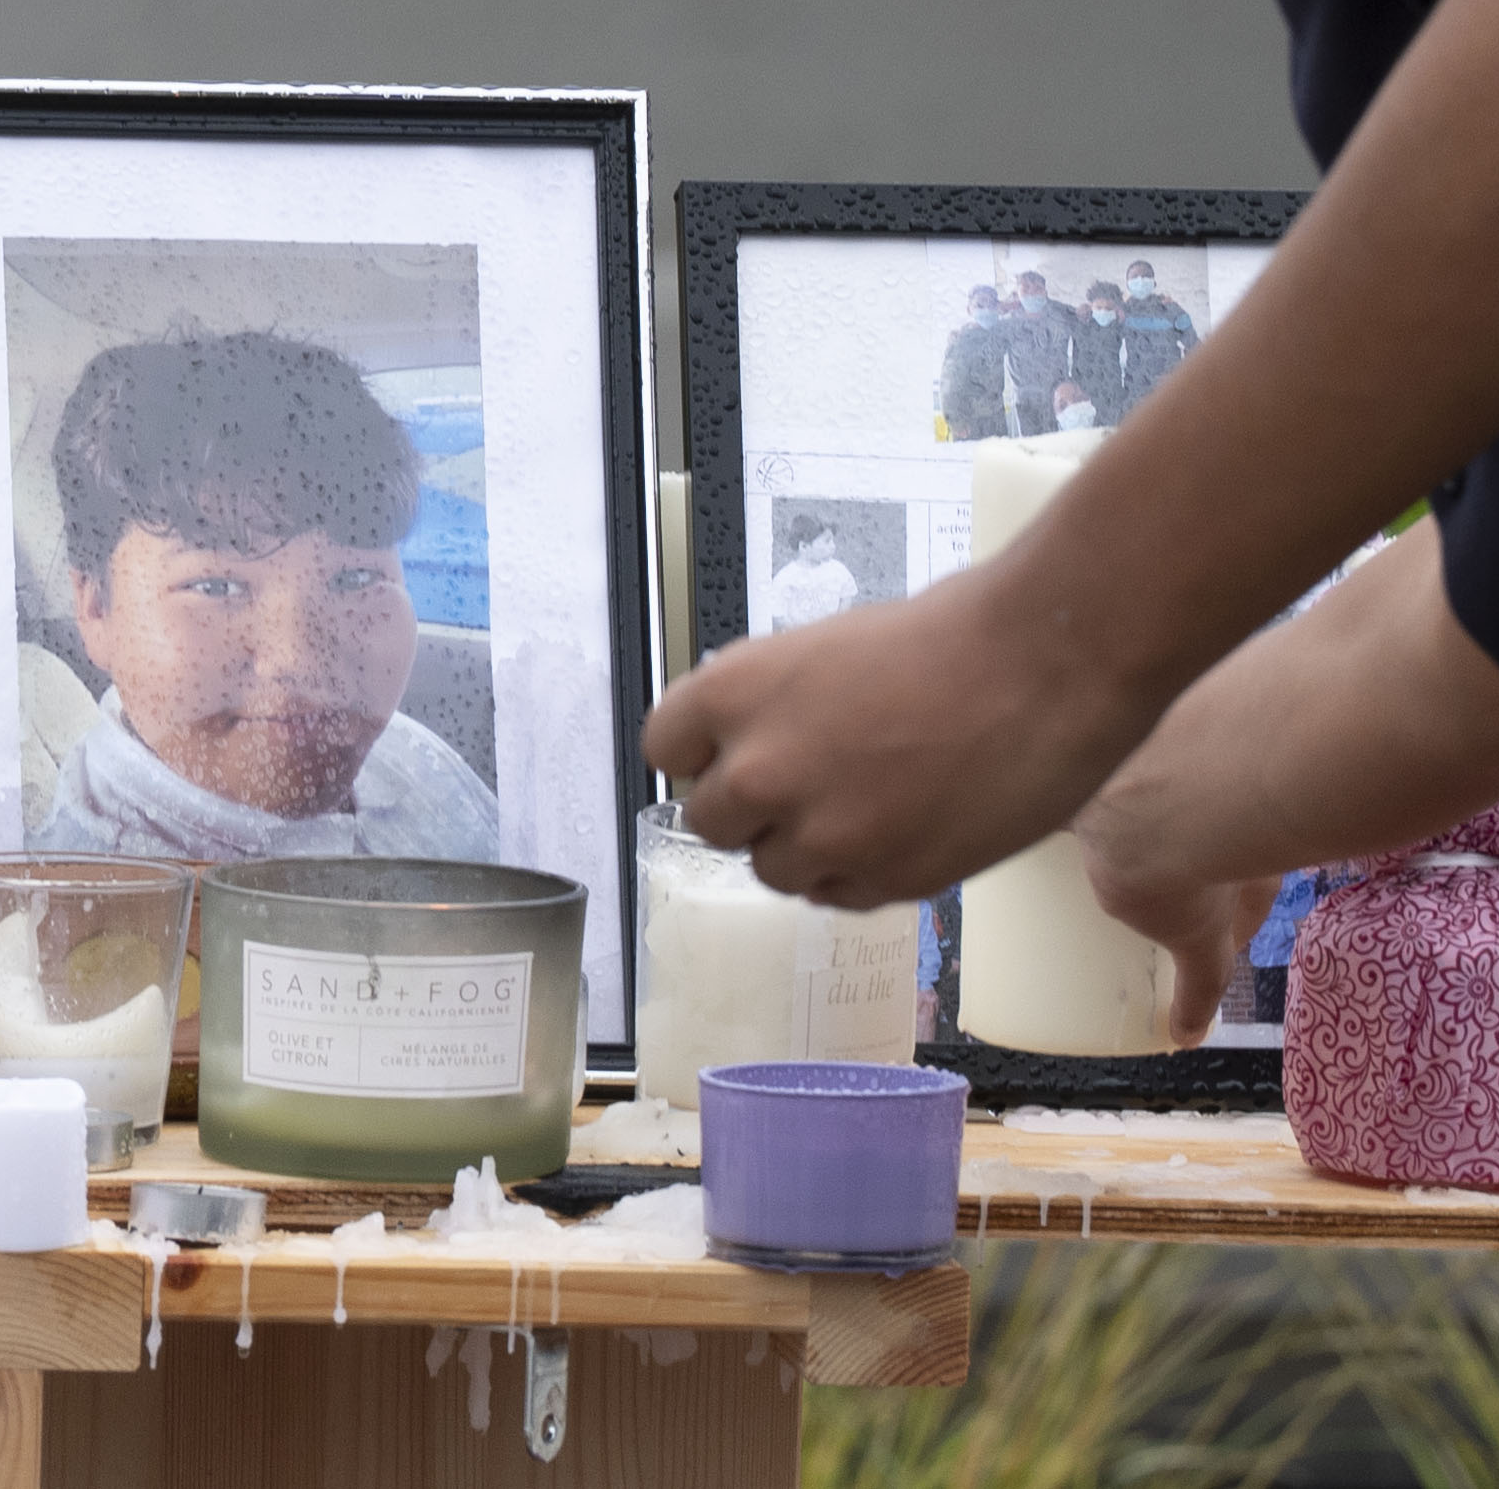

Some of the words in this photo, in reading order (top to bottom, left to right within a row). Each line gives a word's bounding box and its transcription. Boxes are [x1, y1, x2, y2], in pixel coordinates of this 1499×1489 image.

[827, 973, 859, 1005] du
[320, 1003, 336, 1015] DE
[343, 1005, 359, 1015] LA
[408, 1005, 510, 1018] CALIFORNIENNE
[268, 1029, 310, 1049] OLIVE
[316, 1036, 334, 1050] ET
[402, 1041, 468, 1056] MÉLANGE
[473, 1042, 489, 1054] DE
[271, 1048, 329, 1068] CITRON
[380, 1055, 421, 1067] CIRES
[426, 1055, 507, 1067] NATURELLES
